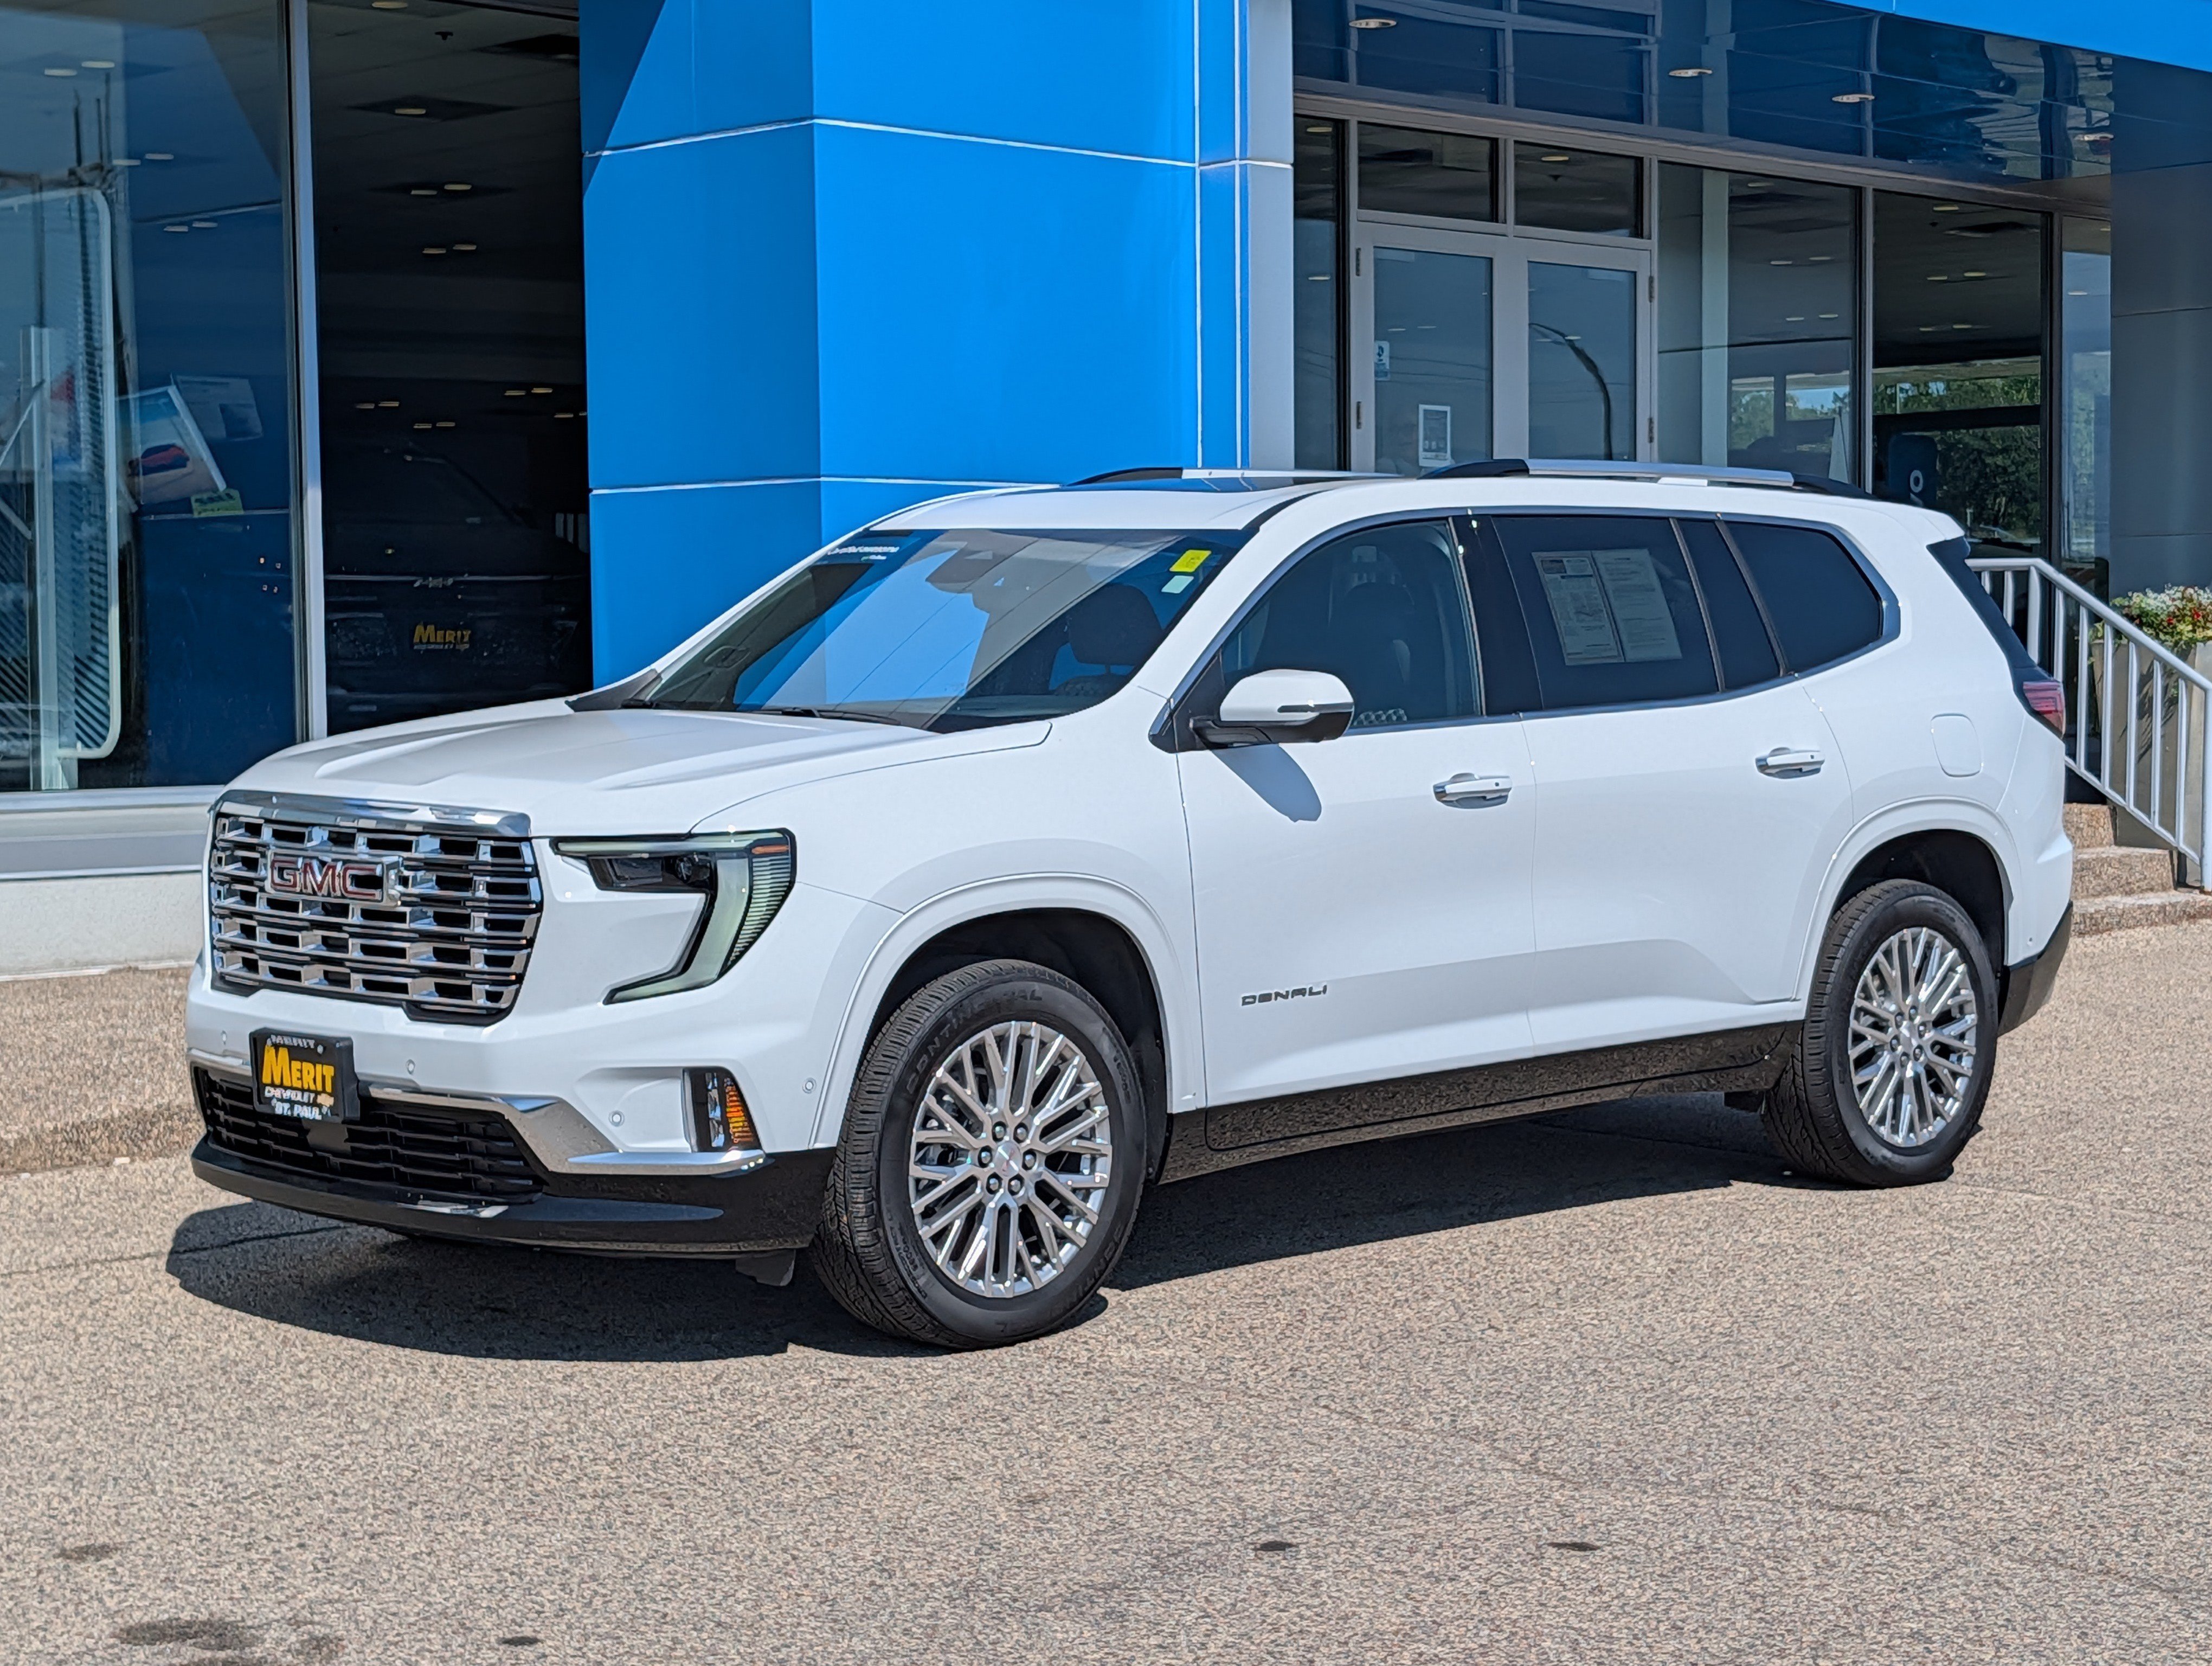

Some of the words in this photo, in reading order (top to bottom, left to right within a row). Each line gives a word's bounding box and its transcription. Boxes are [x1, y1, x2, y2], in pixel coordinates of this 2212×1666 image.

[271, 857, 382, 901] GMC
[1242, 984, 1327, 1006] DENALI
[262, 1044, 335, 1093] MERIT
[293, 1104, 322, 1120] PAUL
